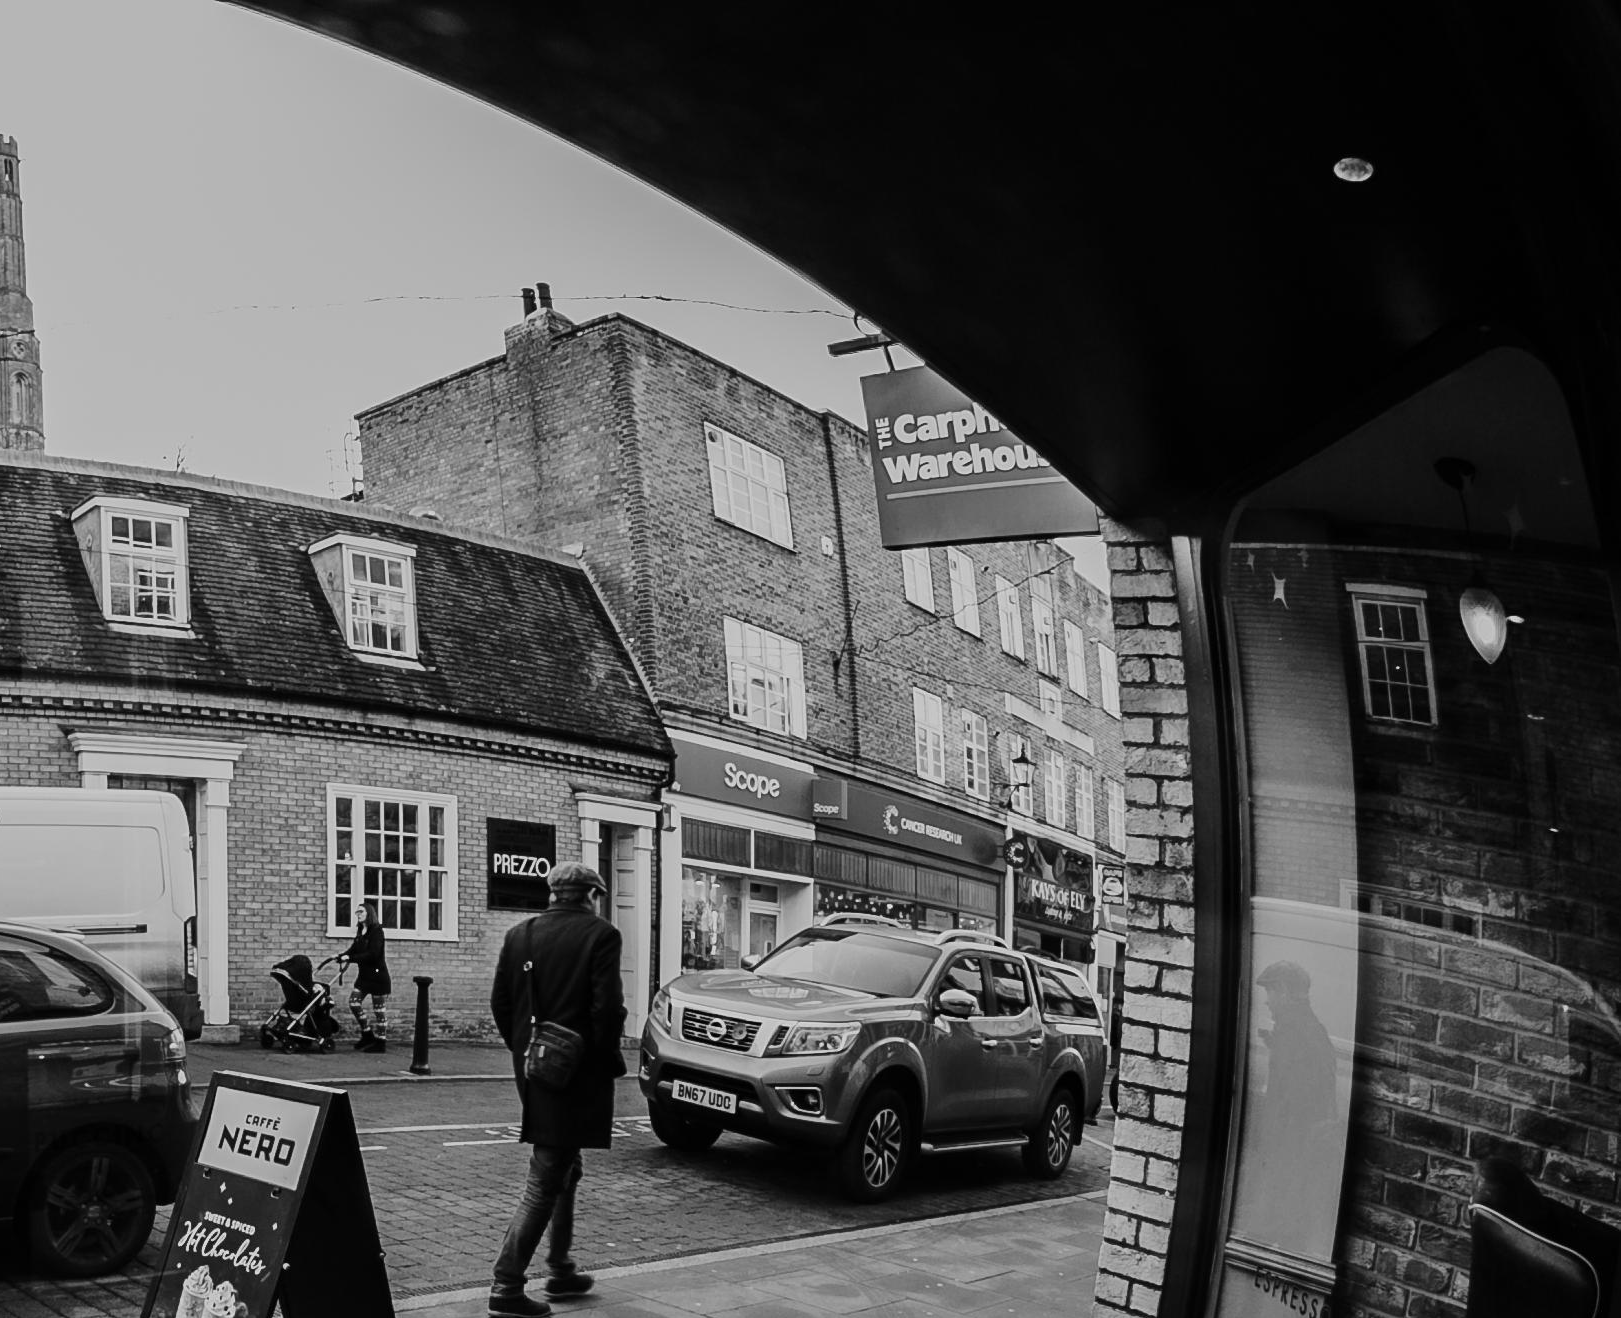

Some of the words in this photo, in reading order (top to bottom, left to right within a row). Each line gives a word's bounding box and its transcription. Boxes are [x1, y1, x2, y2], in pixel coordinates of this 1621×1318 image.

[875, 417, 892, 450] THE
[893, 402, 1007, 443] Carph
[724, 762, 780, 799] Scope
[813, 803, 839, 814] Scope
[900, 818, 925, 834] CANCER
[925, 824, 954, 843] RESEARCH
[953, 833, 963, 845] UK
[493, 853, 551, 877] PREZZO
[1031, 879, 1056, 902] KAYS
[1070, 890, 1086, 911] ELY
[678, 1083, 707, 1103] BN67
[245, 1114, 281, 1131] CAFFÈ
[218, 1124, 296, 1166] NERO
[204, 1211, 226, 1226] SWEET
[231, 1220, 256, 1235] SPICED
[177, 1220, 207, 1252] Hot
[201, 1227, 266, 1275] Chocolates
